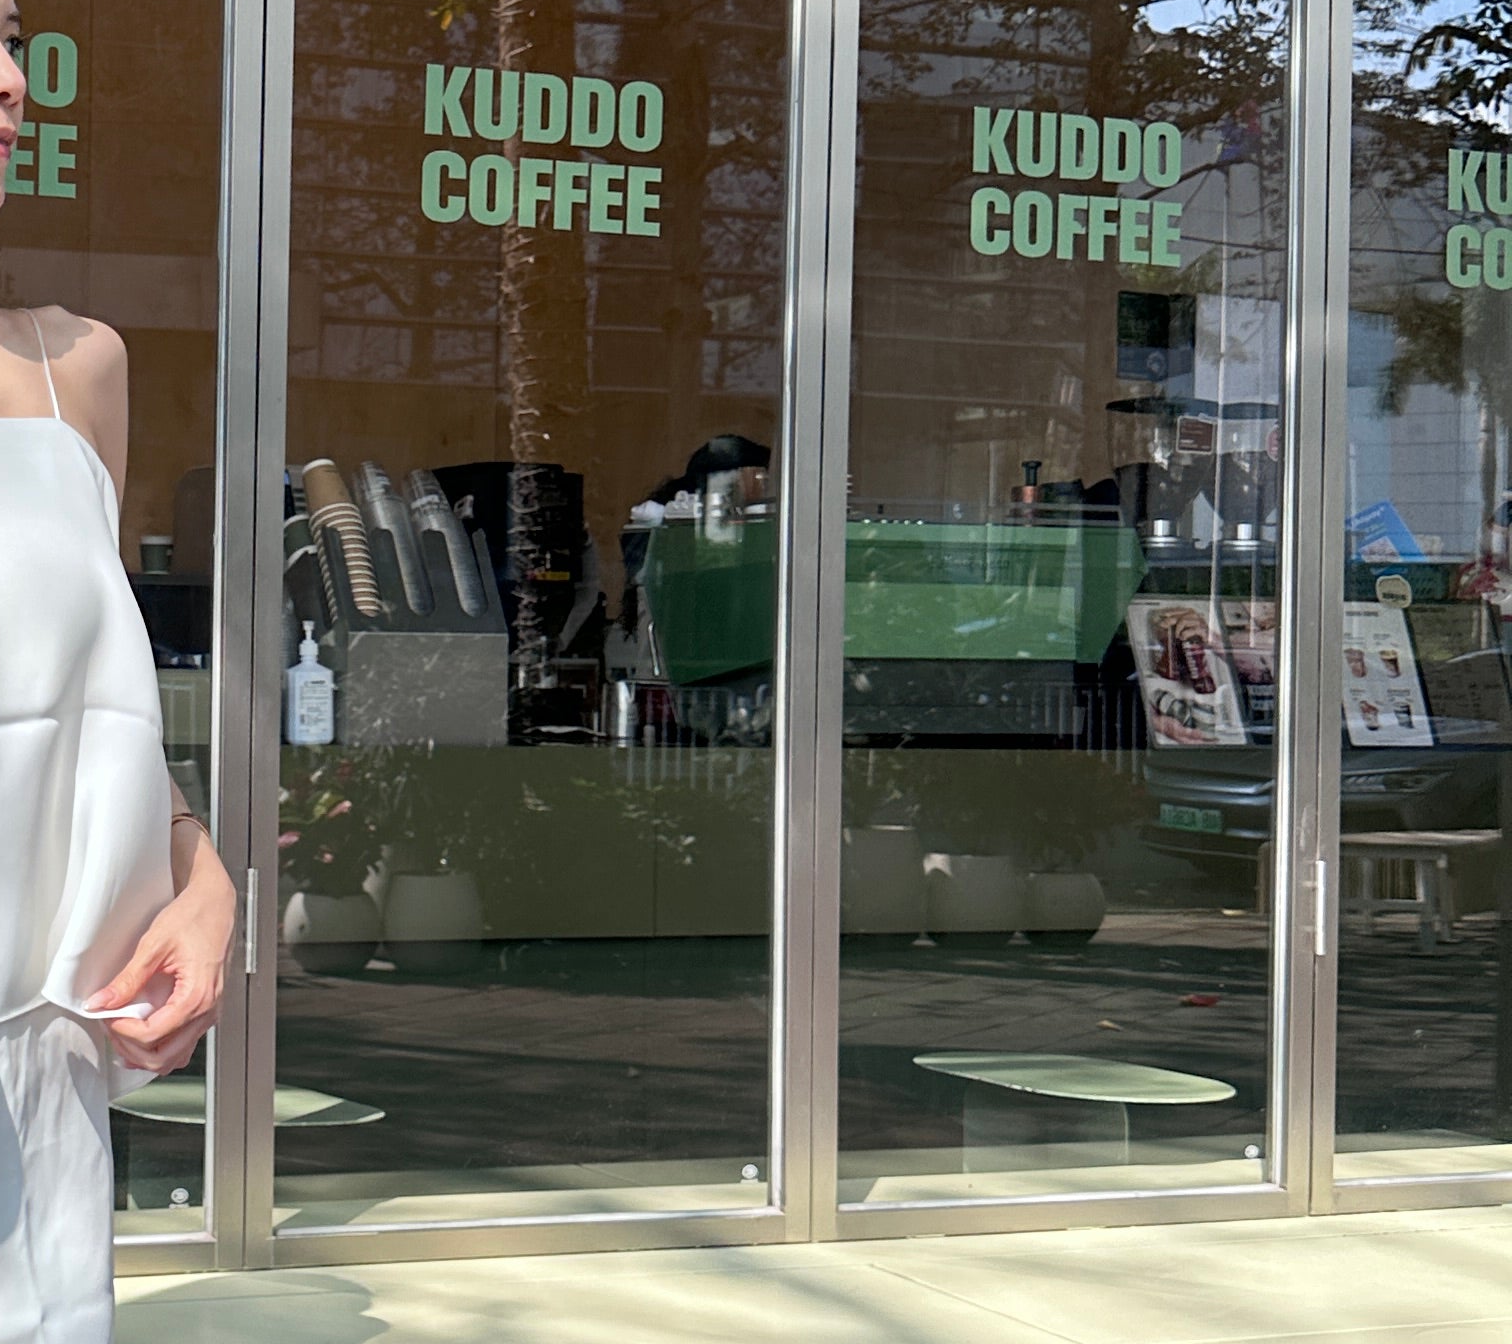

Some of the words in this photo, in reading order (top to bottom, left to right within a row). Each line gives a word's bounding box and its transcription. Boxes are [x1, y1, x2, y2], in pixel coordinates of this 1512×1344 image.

[424, 63, 664, 152] KUDDO
[972, 106, 1182, 188] KUDDO
[421, 150, 662, 237] COFFEE
[970, 187, 1182, 268] COFFEE
